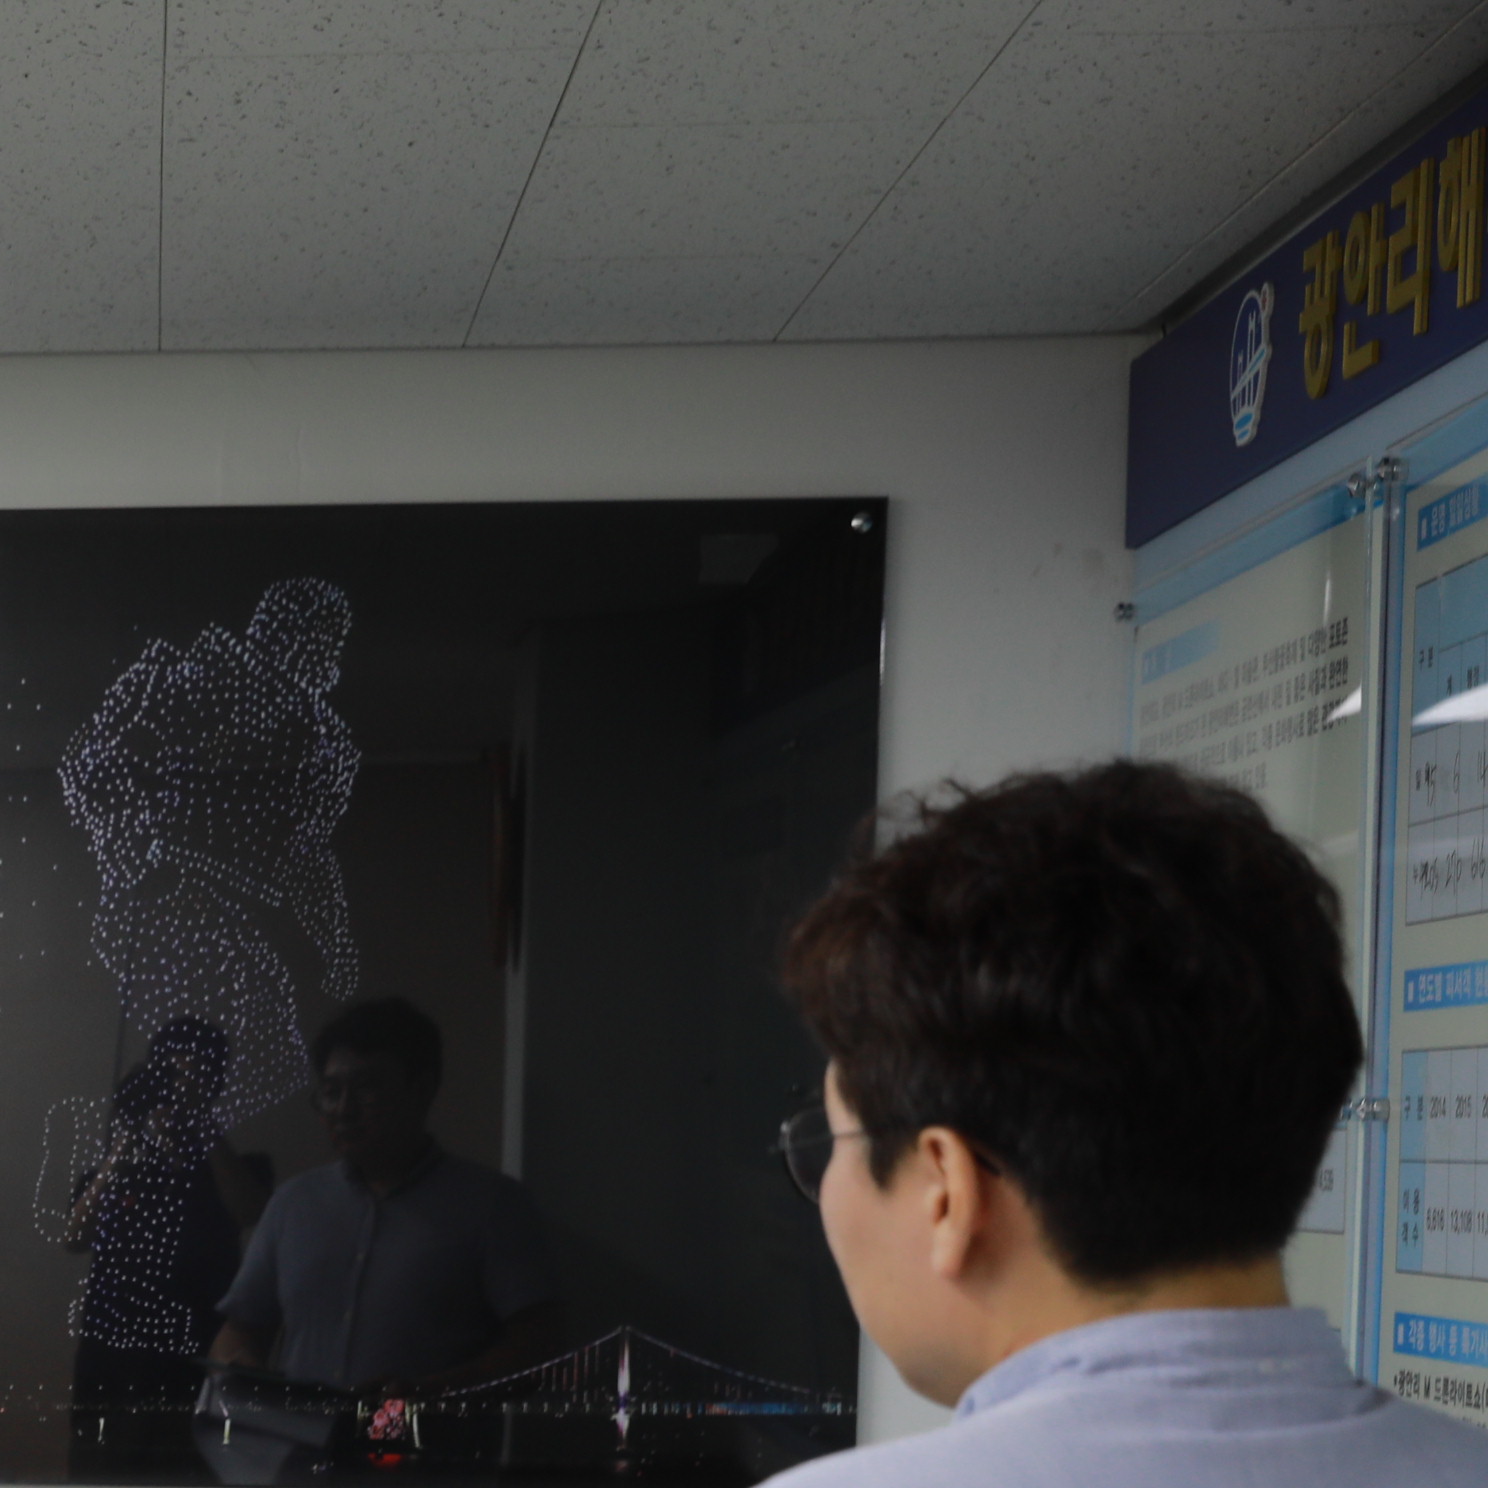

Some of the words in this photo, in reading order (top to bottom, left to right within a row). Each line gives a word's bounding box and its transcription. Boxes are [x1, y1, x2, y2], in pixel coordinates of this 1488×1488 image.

[1430, 1096, 1446, 1118] 2014
[1455, 1094, 1471, 1118] 2015
[1409, 1320, 1424, 1351] 각종
[1429, 1321, 1445, 1354] 행사
[1399, 1369, 1420, 1399] 광안리
[1424, 1375, 1430, 1398] M
